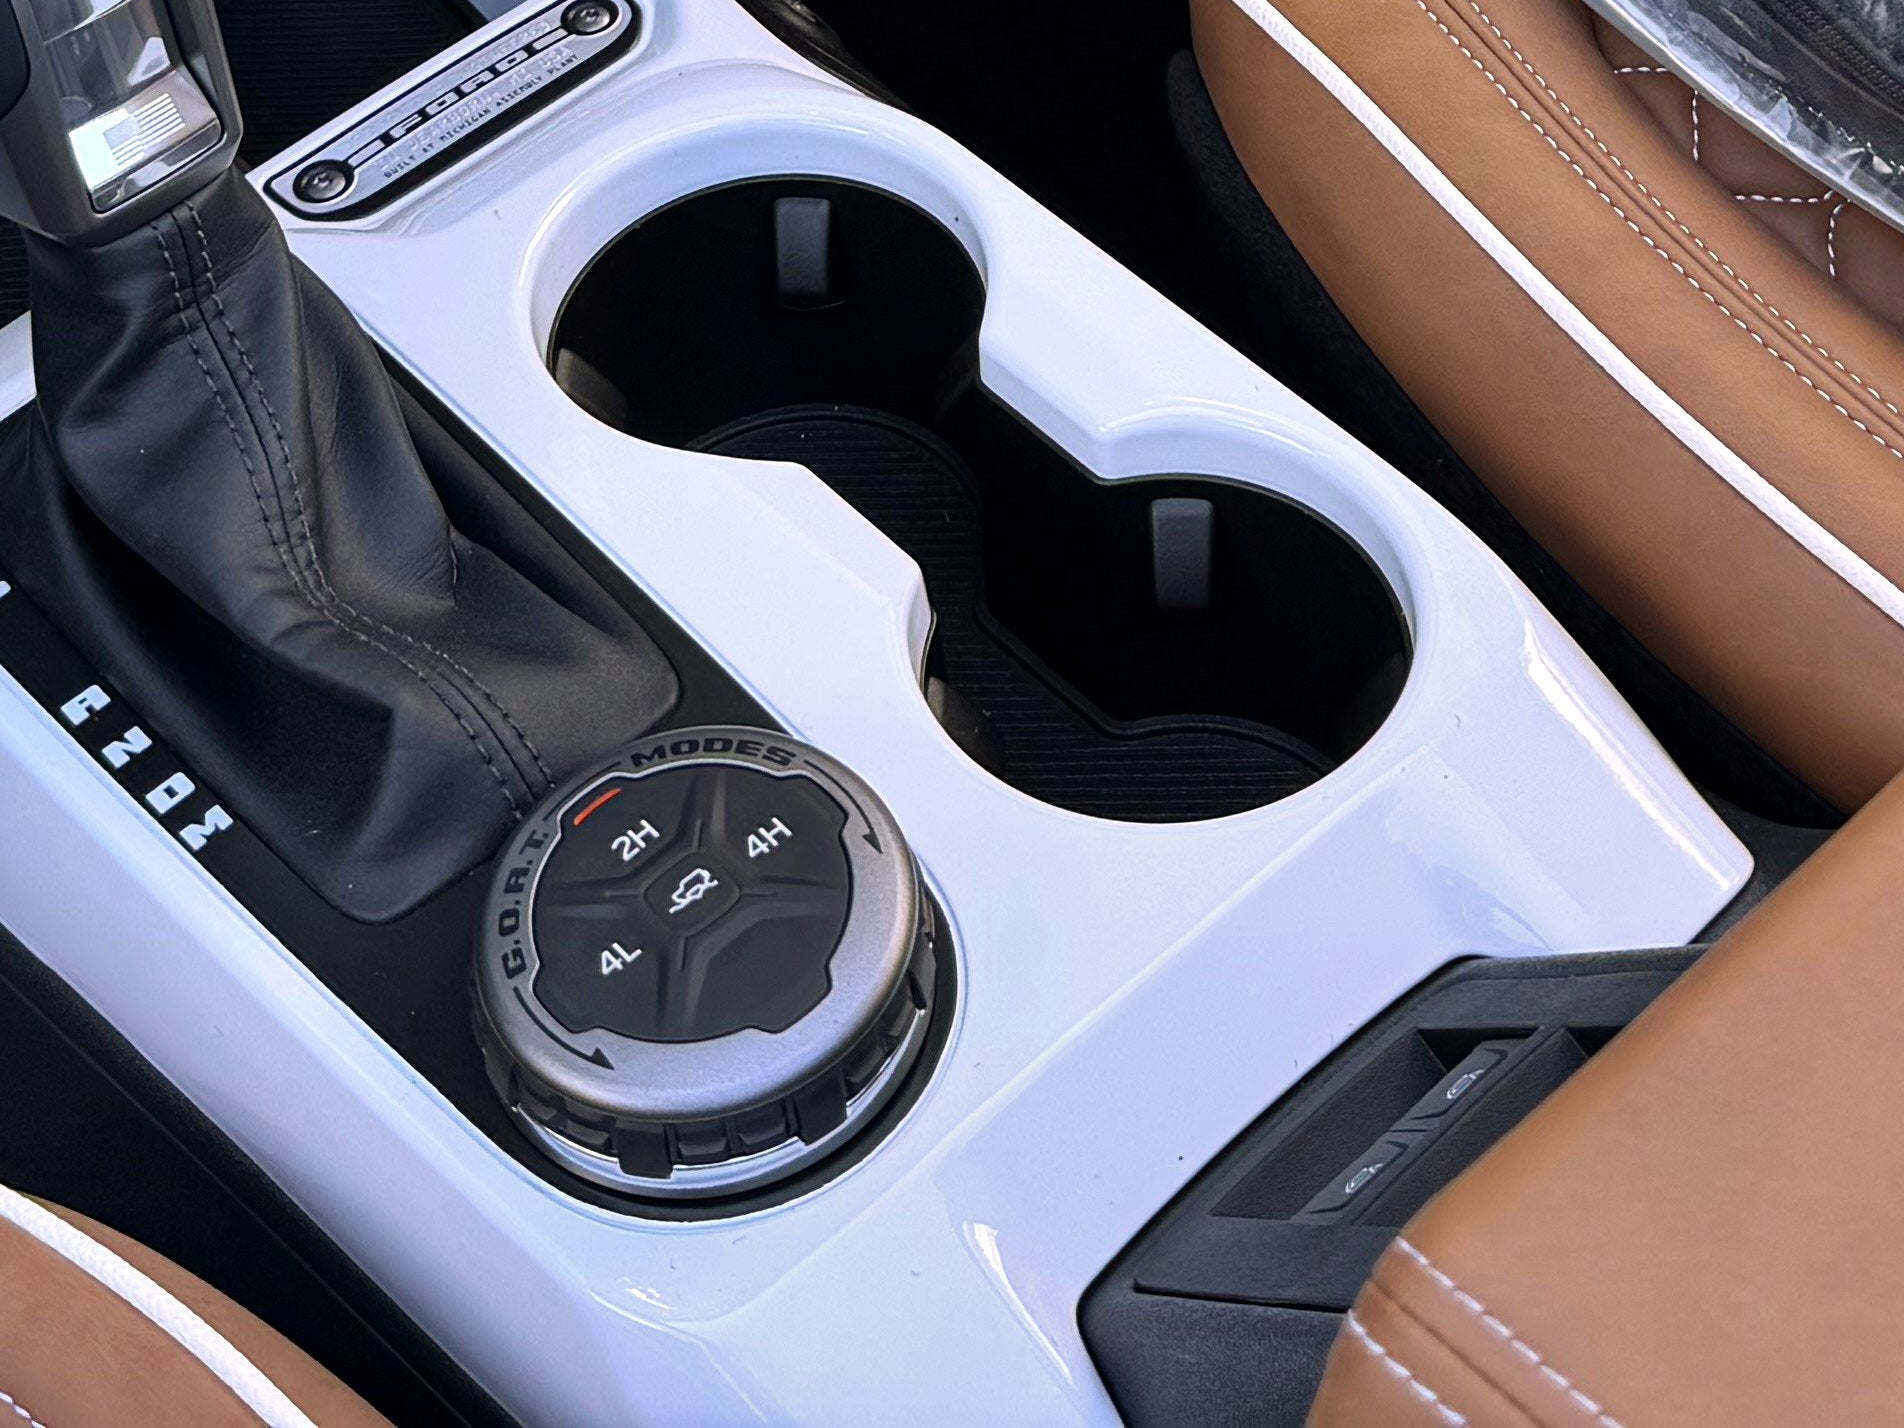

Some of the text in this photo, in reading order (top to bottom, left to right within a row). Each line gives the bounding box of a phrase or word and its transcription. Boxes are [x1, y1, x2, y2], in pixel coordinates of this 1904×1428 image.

[389, 49, 529, 139] FORD
[438, 107, 492, 142] MICHIGAN
[547, 53, 579, 76] PLANT
[60, 684, 110, 726] R
[103, 725, 152, 769] N
[147, 771, 196, 813] D
[188, 806, 233, 851] M
[629, 736, 798, 769] MODES
[610, 818, 660, 862] 2H
[744, 815, 793, 861] 4H
[502, 827, 552, 982] G.O.A.T.
[598, 937, 642, 978] 4L
